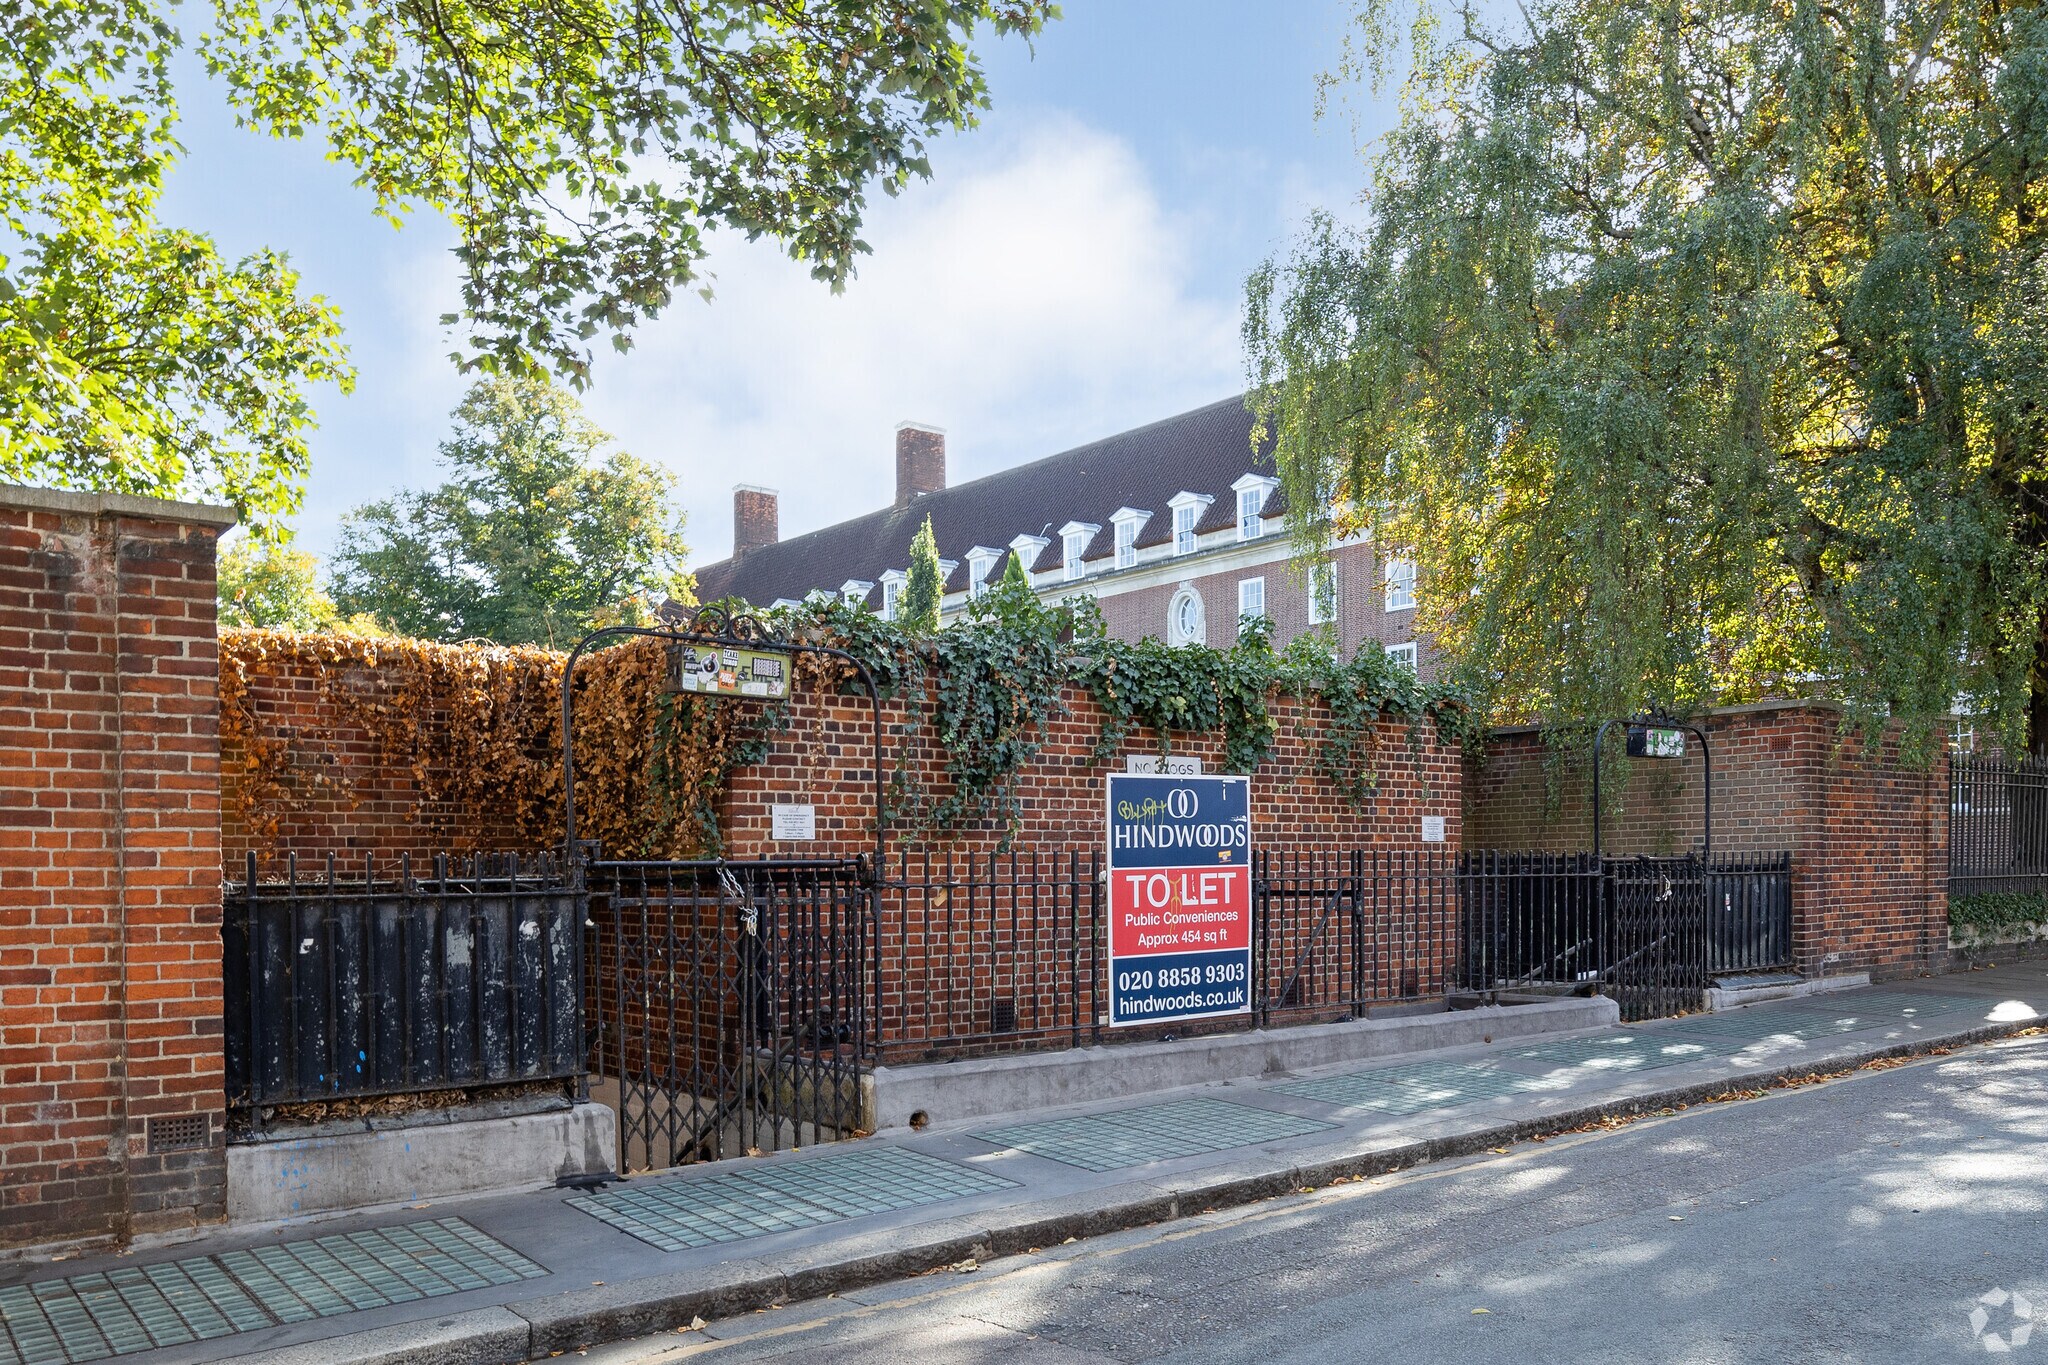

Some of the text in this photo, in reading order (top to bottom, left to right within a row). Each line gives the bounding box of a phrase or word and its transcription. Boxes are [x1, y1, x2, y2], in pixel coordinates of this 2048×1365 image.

[1134, 762, 1195, 775] NO OGS
[1114, 823, 1247, 849] HINDWOODS
[1125, 872, 1237, 909] TO LET
[1125, 910, 1239, 927] Public Conveniences
[1137, 928, 1228, 949] Approx 454 sq ft
[1118, 962, 1245, 992] 020 8858 9303
[1119, 986, 1244, 1015] hindwoods.co.uk
